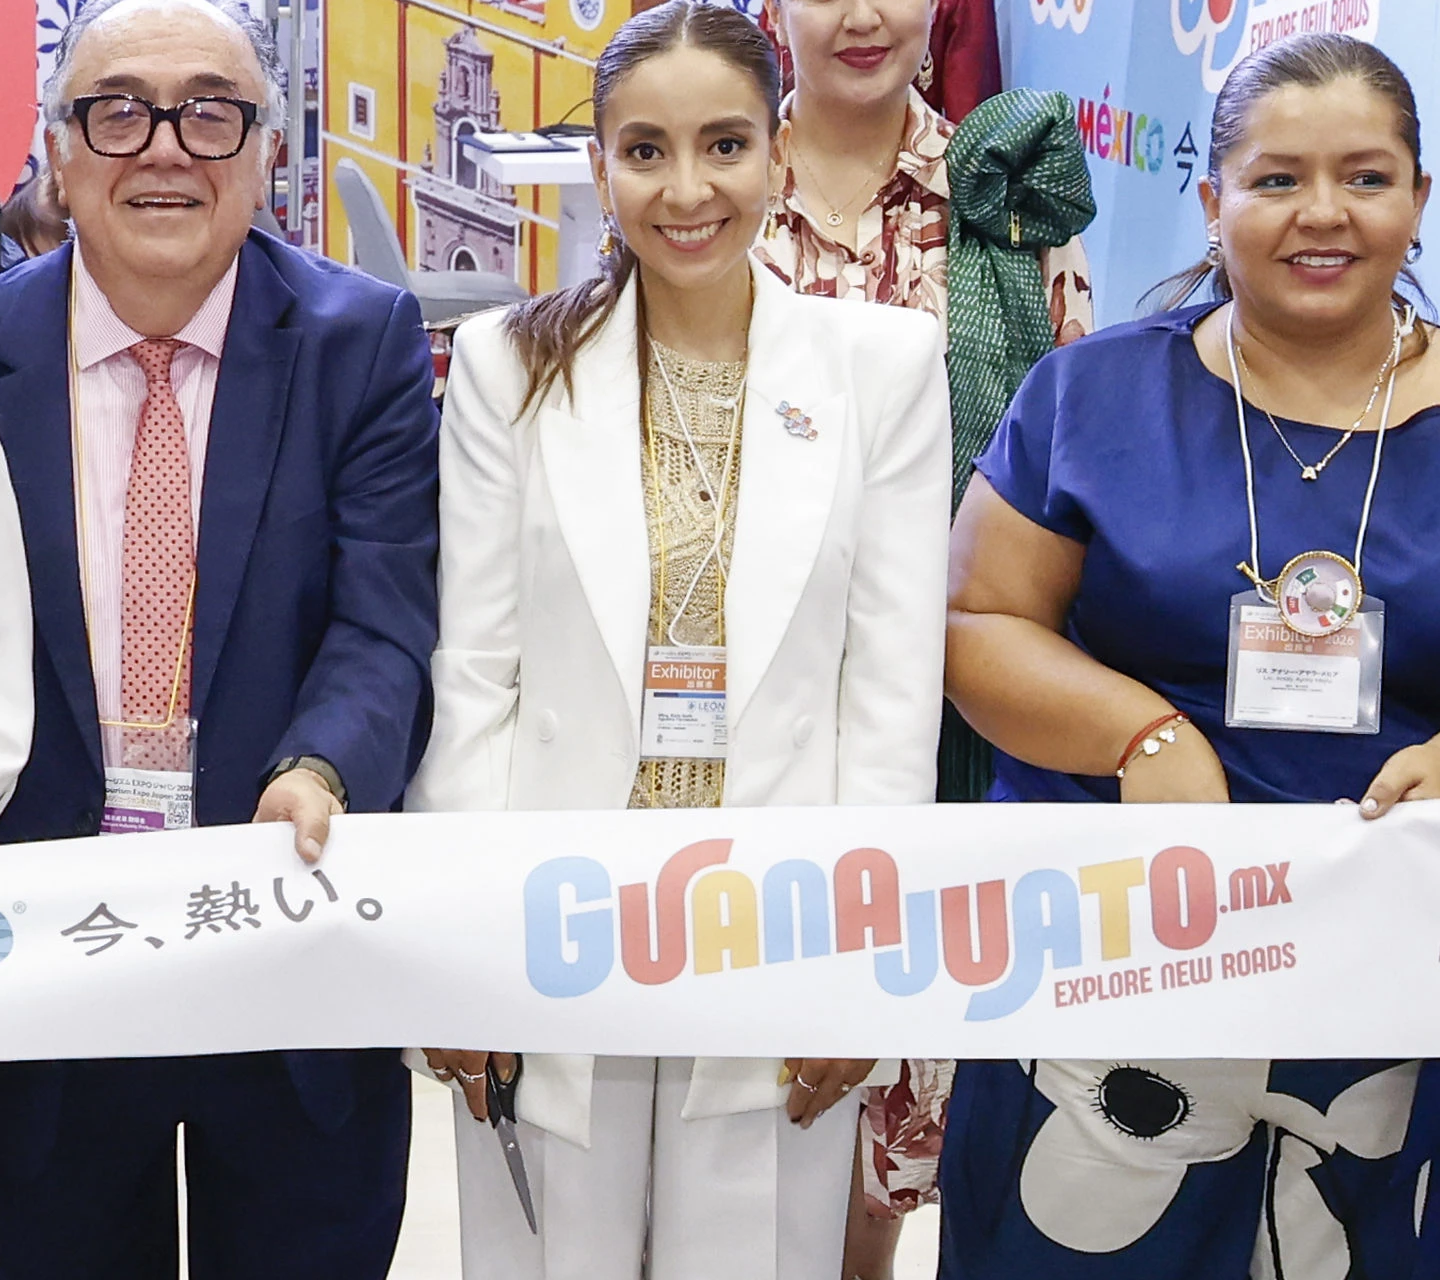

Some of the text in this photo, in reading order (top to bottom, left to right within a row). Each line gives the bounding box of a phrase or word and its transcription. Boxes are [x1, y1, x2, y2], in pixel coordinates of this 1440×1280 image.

[651, 664, 720, 680] Exhibitor
[60, 868, 383, 957] 今、熱い。
[1054, 941, 1297, 1009] EXPLORE NEW ROADS
